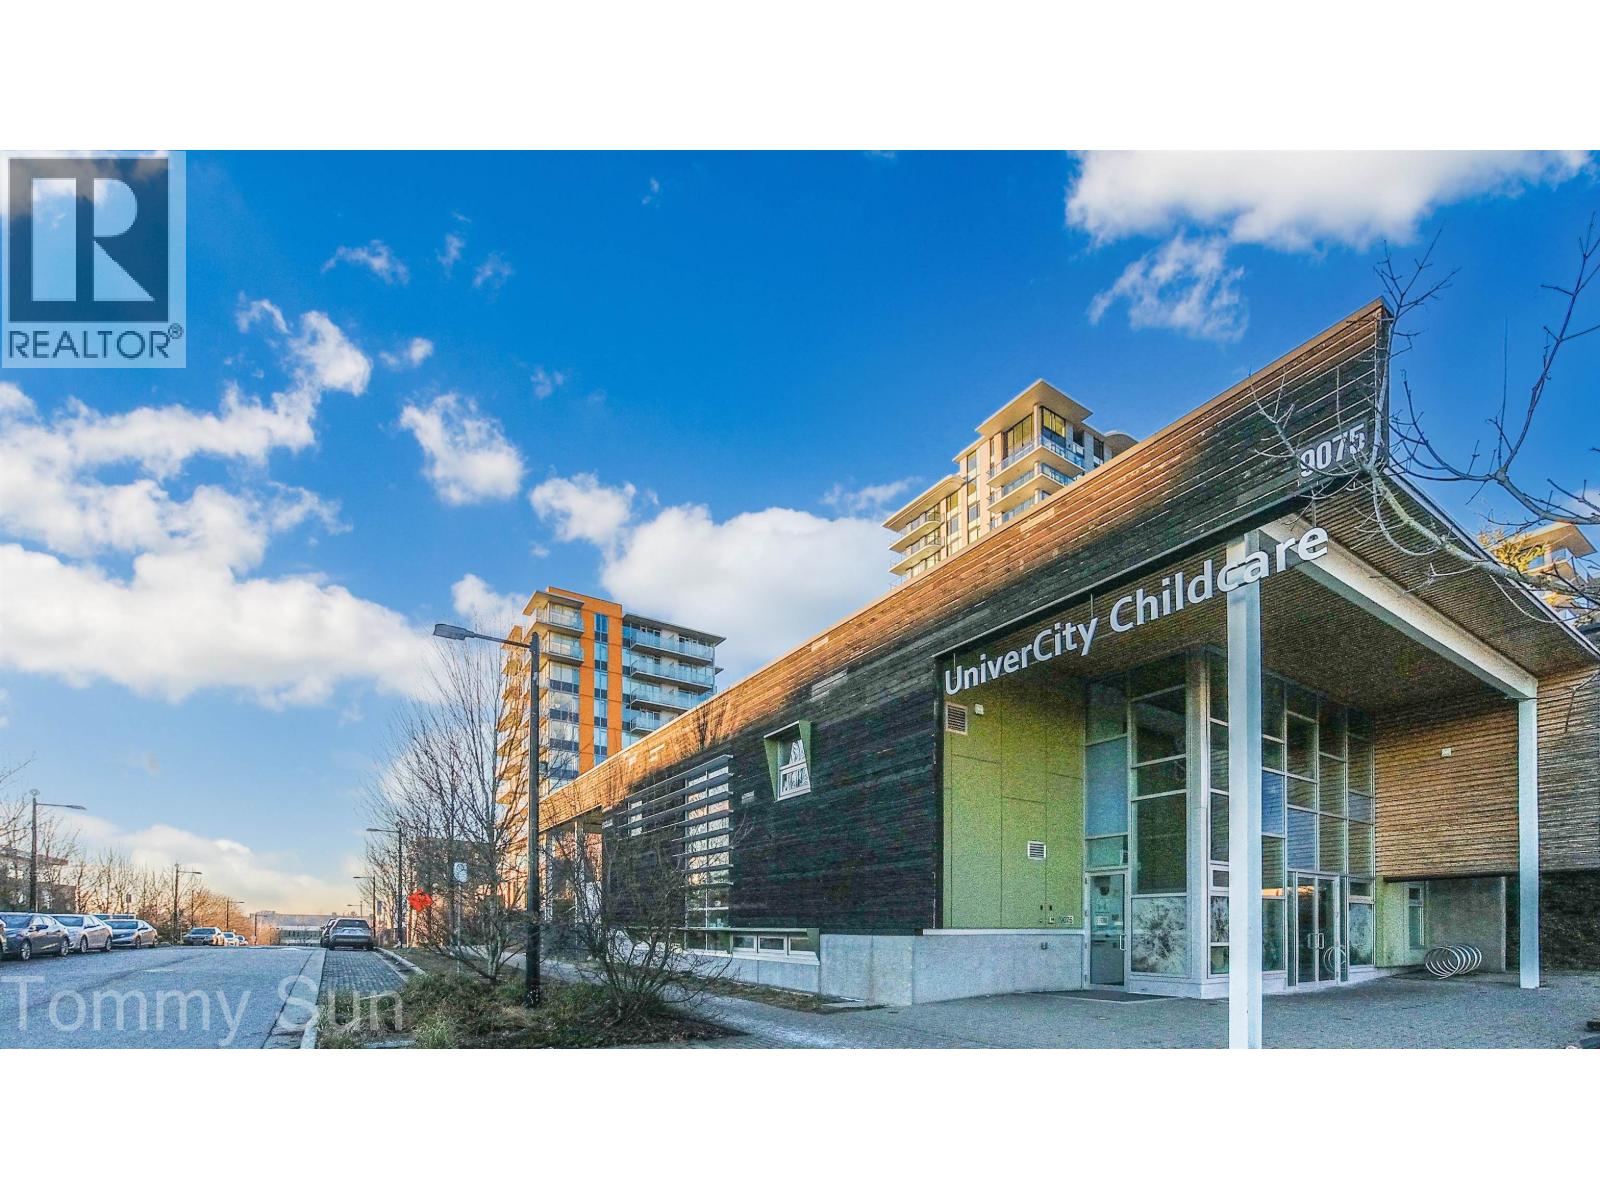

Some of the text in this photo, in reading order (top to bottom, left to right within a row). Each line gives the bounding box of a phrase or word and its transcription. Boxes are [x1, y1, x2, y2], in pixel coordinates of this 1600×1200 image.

[1300, 423, 1366, 477] 9075
[945, 527, 1329, 695] UniverCity Childcare
